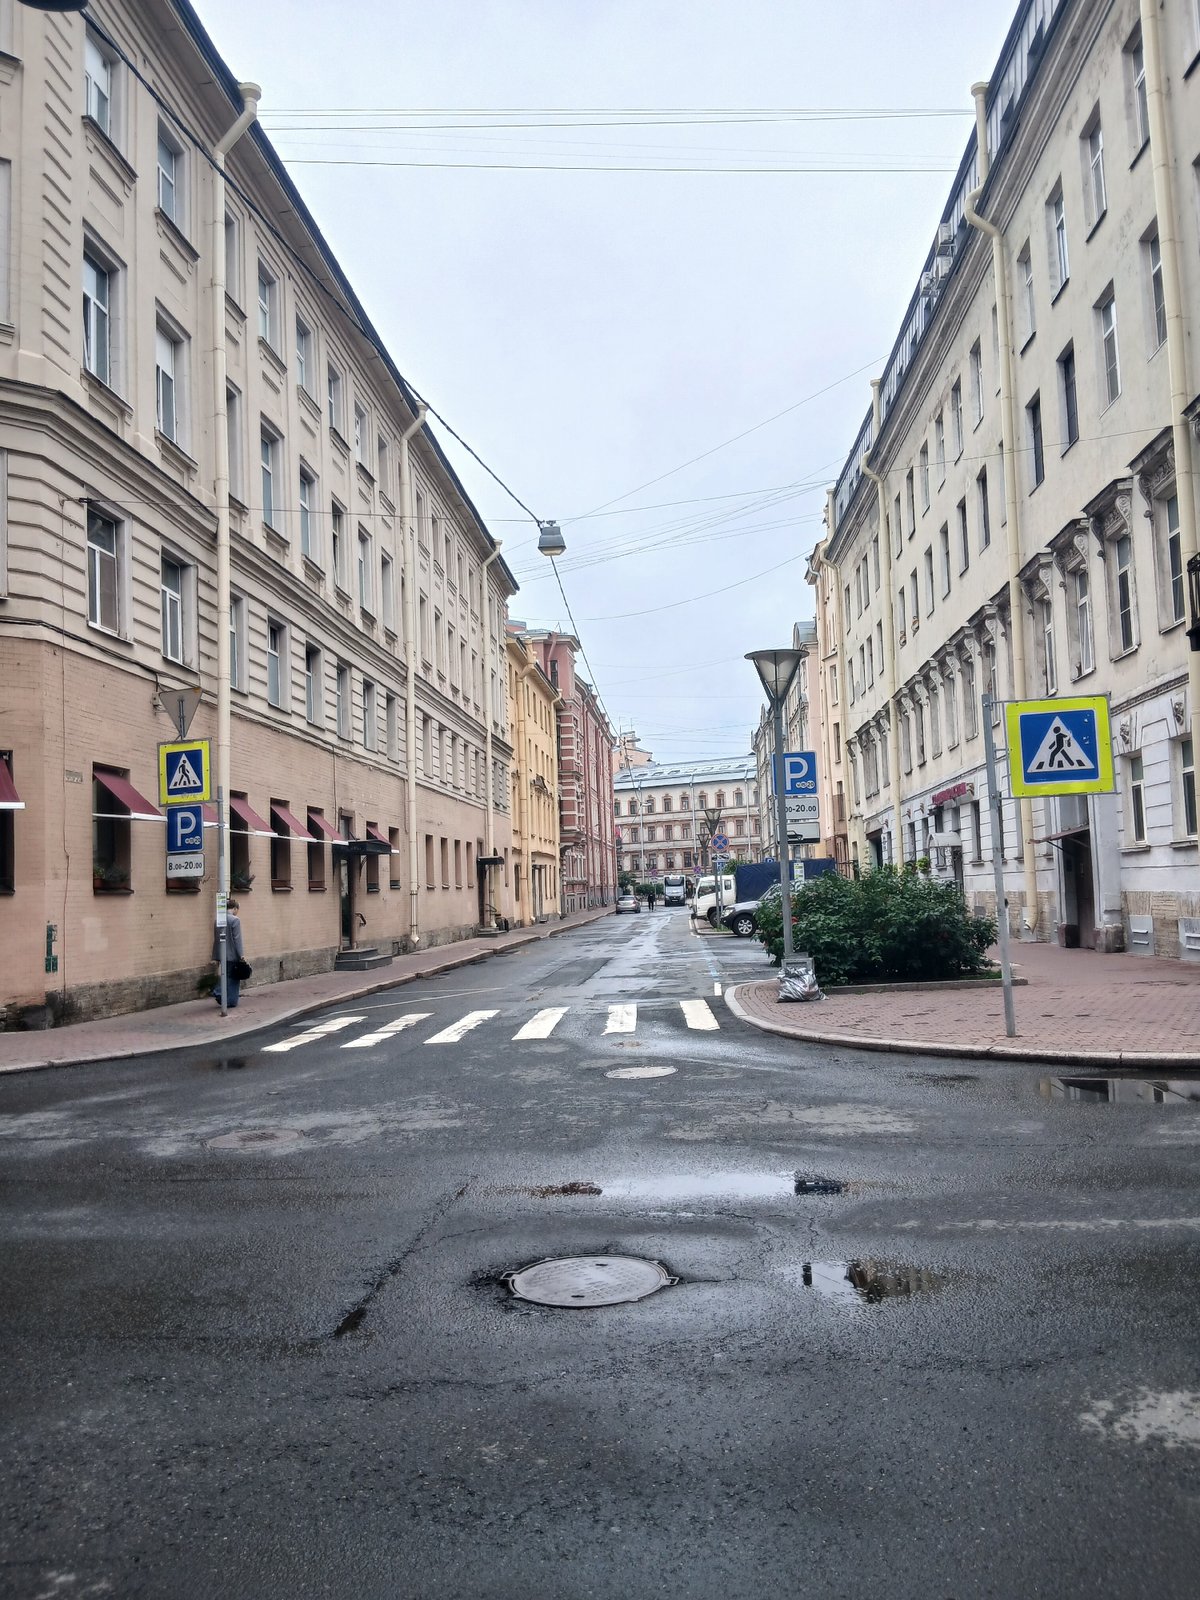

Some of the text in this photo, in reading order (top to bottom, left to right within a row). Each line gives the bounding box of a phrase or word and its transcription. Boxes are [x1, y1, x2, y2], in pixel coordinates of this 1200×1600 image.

[785, 757, 808, 791] P
[177, 811, 196, 847] P
[168, 861, 202, 871] 8.00-20.00
